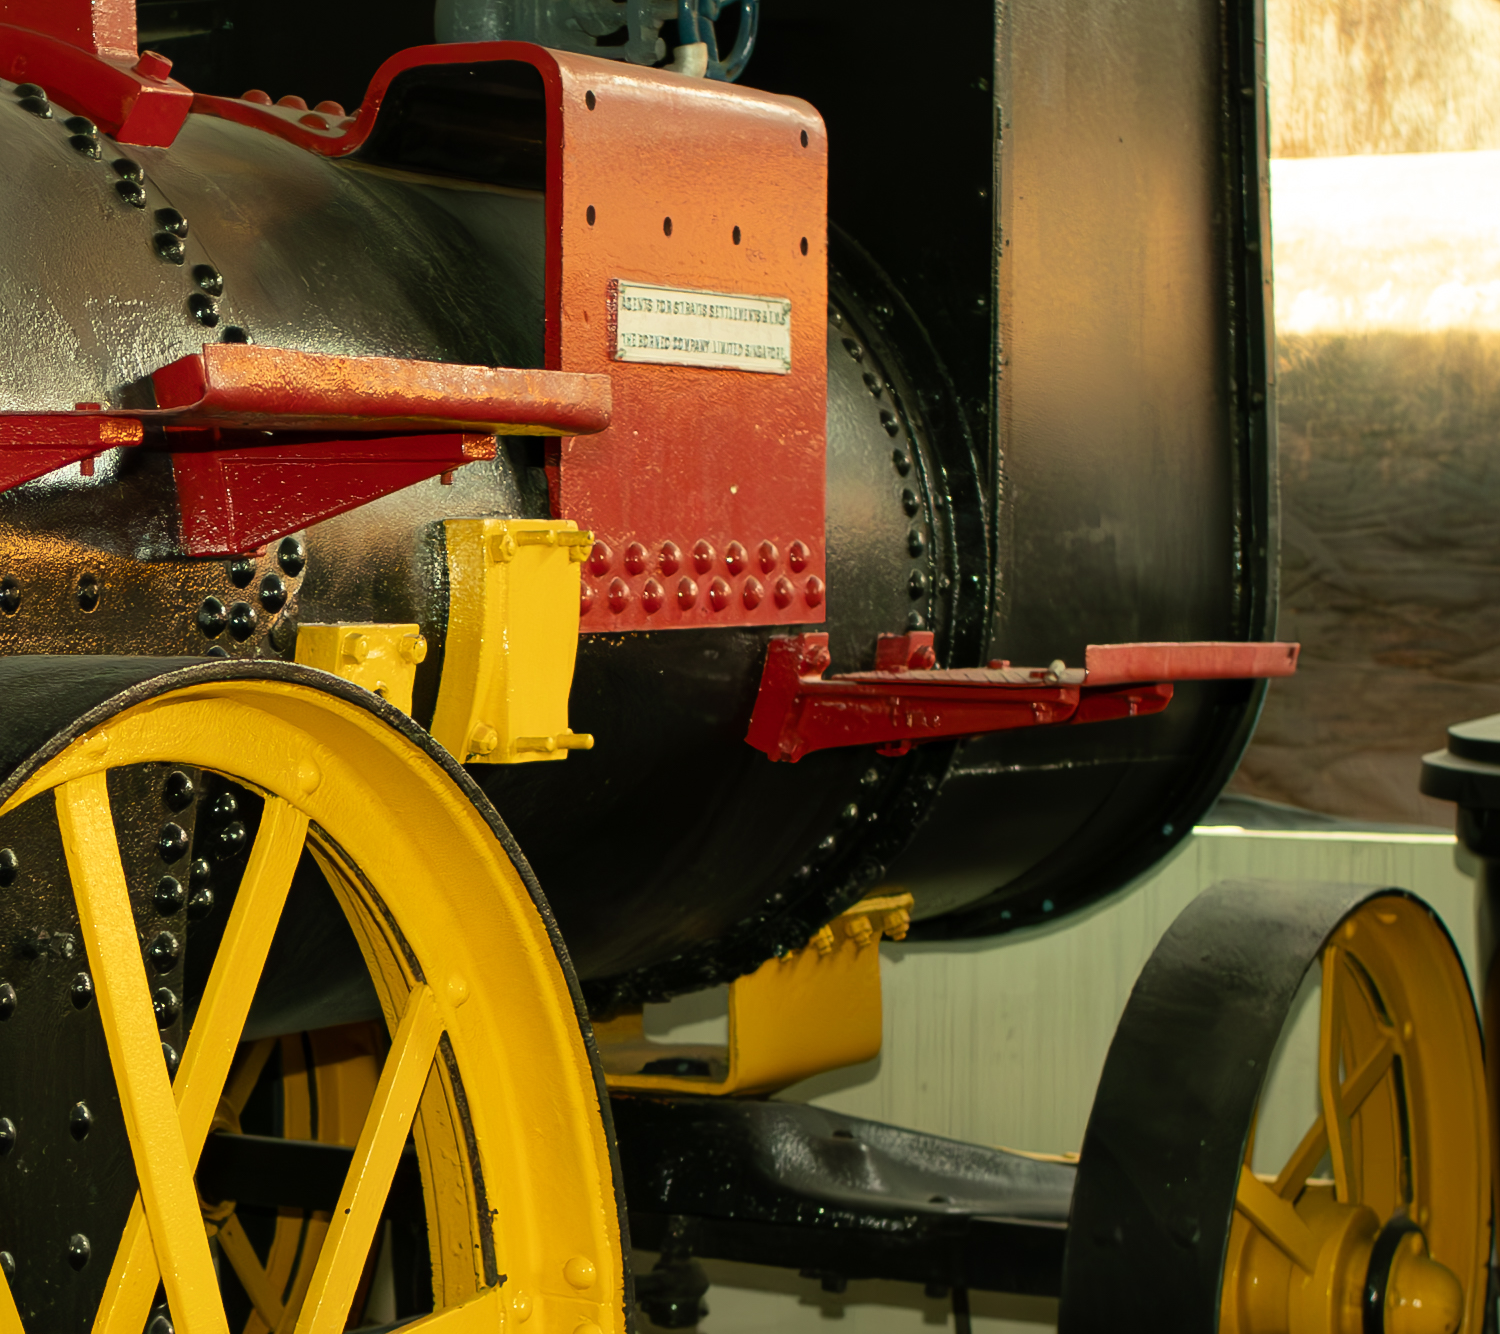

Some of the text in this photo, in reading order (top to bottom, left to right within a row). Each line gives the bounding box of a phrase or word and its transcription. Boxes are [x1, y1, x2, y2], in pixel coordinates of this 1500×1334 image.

[621, 296, 653, 312] AGENTS
[656, 299, 672, 313] FOR
[673, 301, 708, 318] STRAITS
[709, 304, 761, 323] SETTLEMENTS
[621, 333, 636, 347] THE
[637, 334, 670, 350] BORNEO
[672, 336, 710, 353] COMPANY
[712, 340, 743, 357] LIMITED
